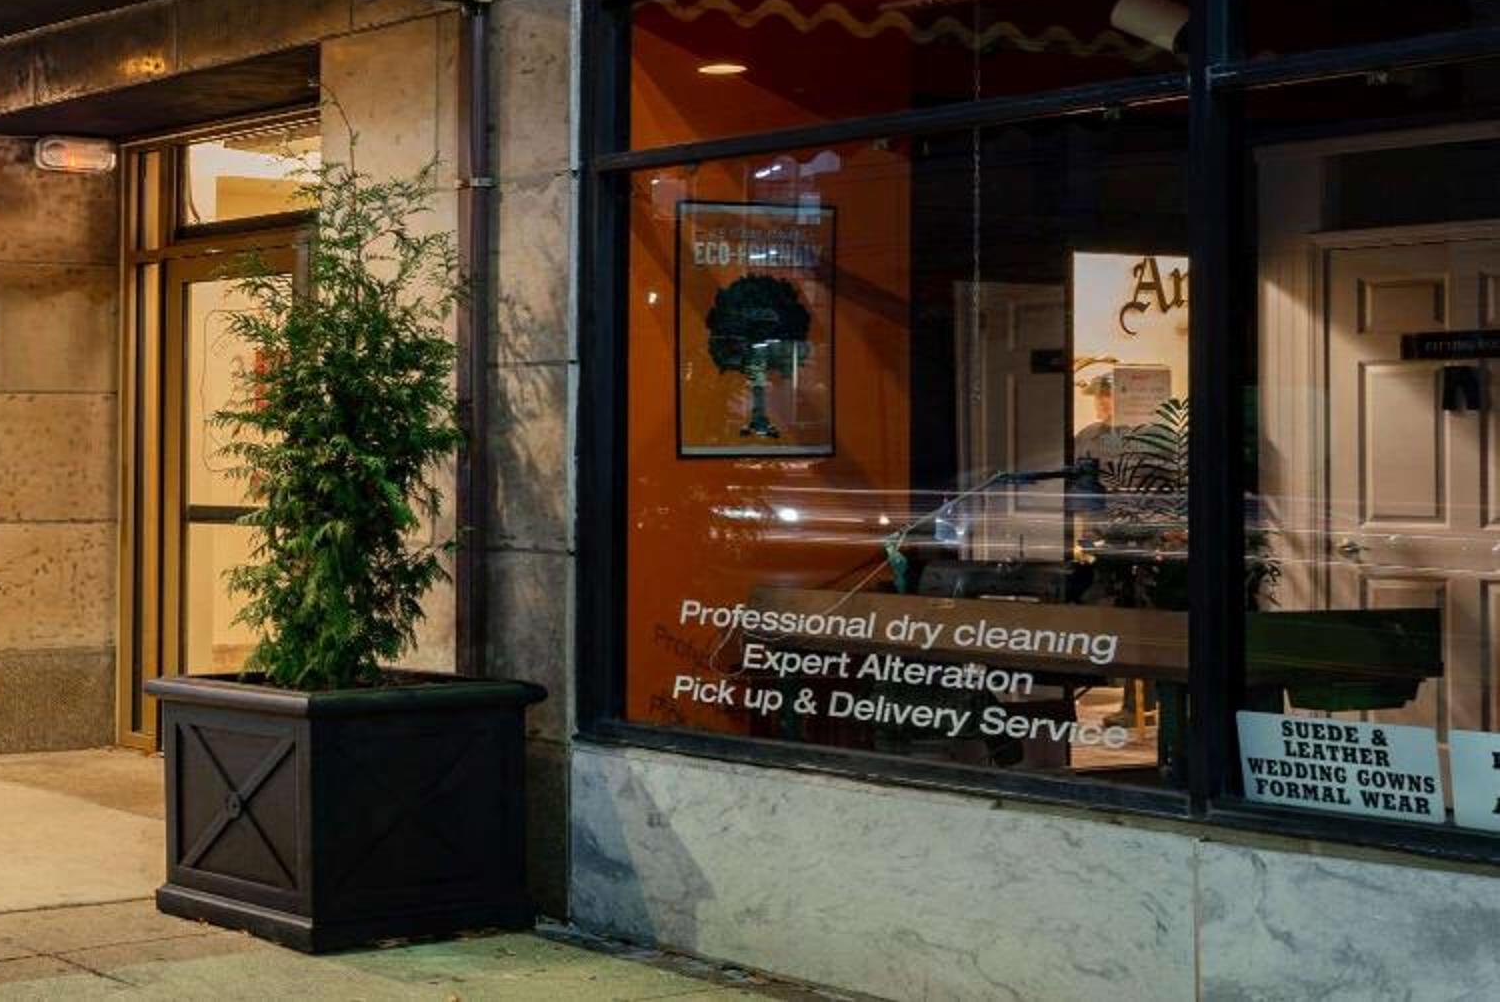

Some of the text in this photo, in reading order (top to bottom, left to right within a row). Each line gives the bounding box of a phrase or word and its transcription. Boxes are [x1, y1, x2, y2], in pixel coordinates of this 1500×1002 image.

[680, 600, 1118, 664] Professional dry cleaning
[742, 644, 1034, 695] Expert Alteration
[673, 675, 1128, 749] Pick up & Delivery Service
[1281, 720, 1388, 746] SUEDE &
[1283, 740, 1390, 767] LEATHER
[1248, 758, 1436, 794] WEDDING GOWNS
[1255, 778, 1431, 815] FORMAL WEAR
